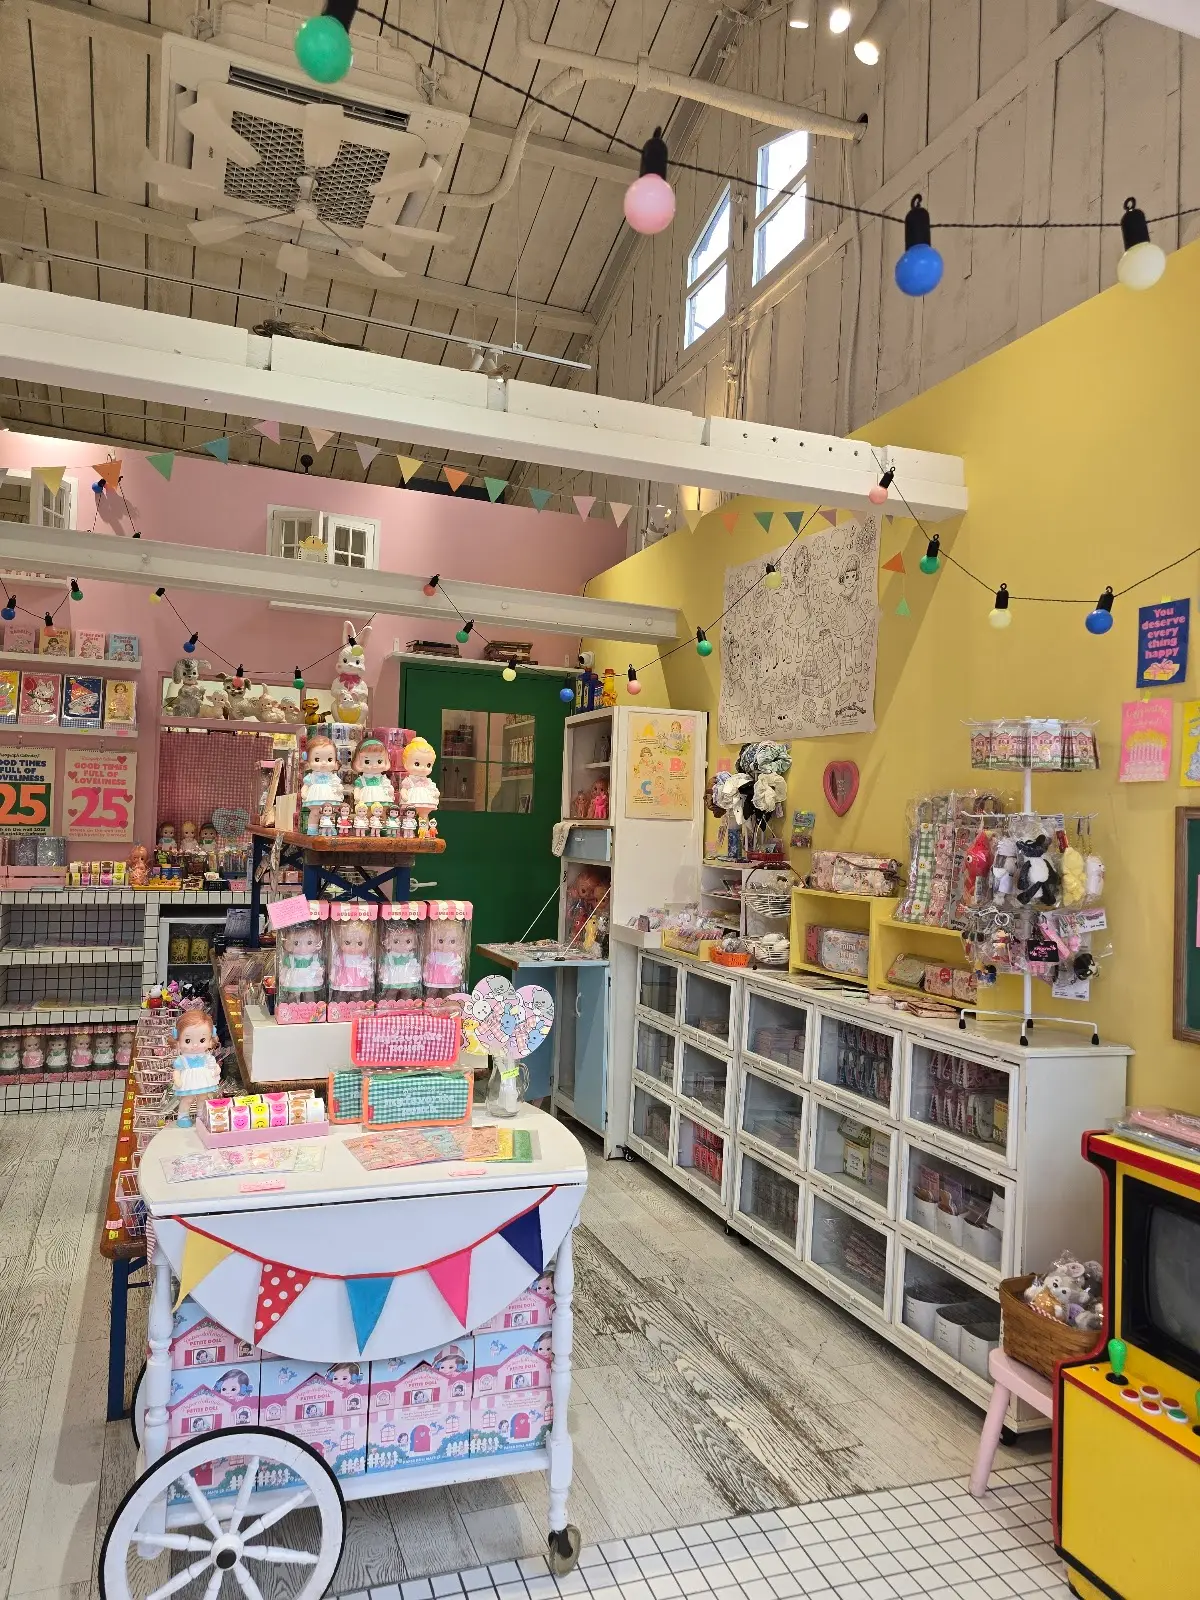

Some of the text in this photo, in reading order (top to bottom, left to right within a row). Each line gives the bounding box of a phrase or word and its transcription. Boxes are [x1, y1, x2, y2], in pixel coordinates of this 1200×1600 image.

[1153, 608, 1174, 618] You
[1142, 616, 1186, 630] deserve
[1147, 627, 1179, 638] every
[1147, 638, 1178, 648] thing
[1145, 647, 1180, 659] happy
[74, 762, 128, 771] GOOD TIMES
[669, 757, 681, 772] B
[84, 769, 118, 778] FULL OF
[75, 777, 127, 786] LOVELINESS
[640, 780, 653, 796] C
[0, 783, 47, 825] 25
[69, 787, 129, 828] 25
[840, 943, 856, 951] mini
[837, 950, 859, 960] string
[389, 1042, 426, 1055] pouch
